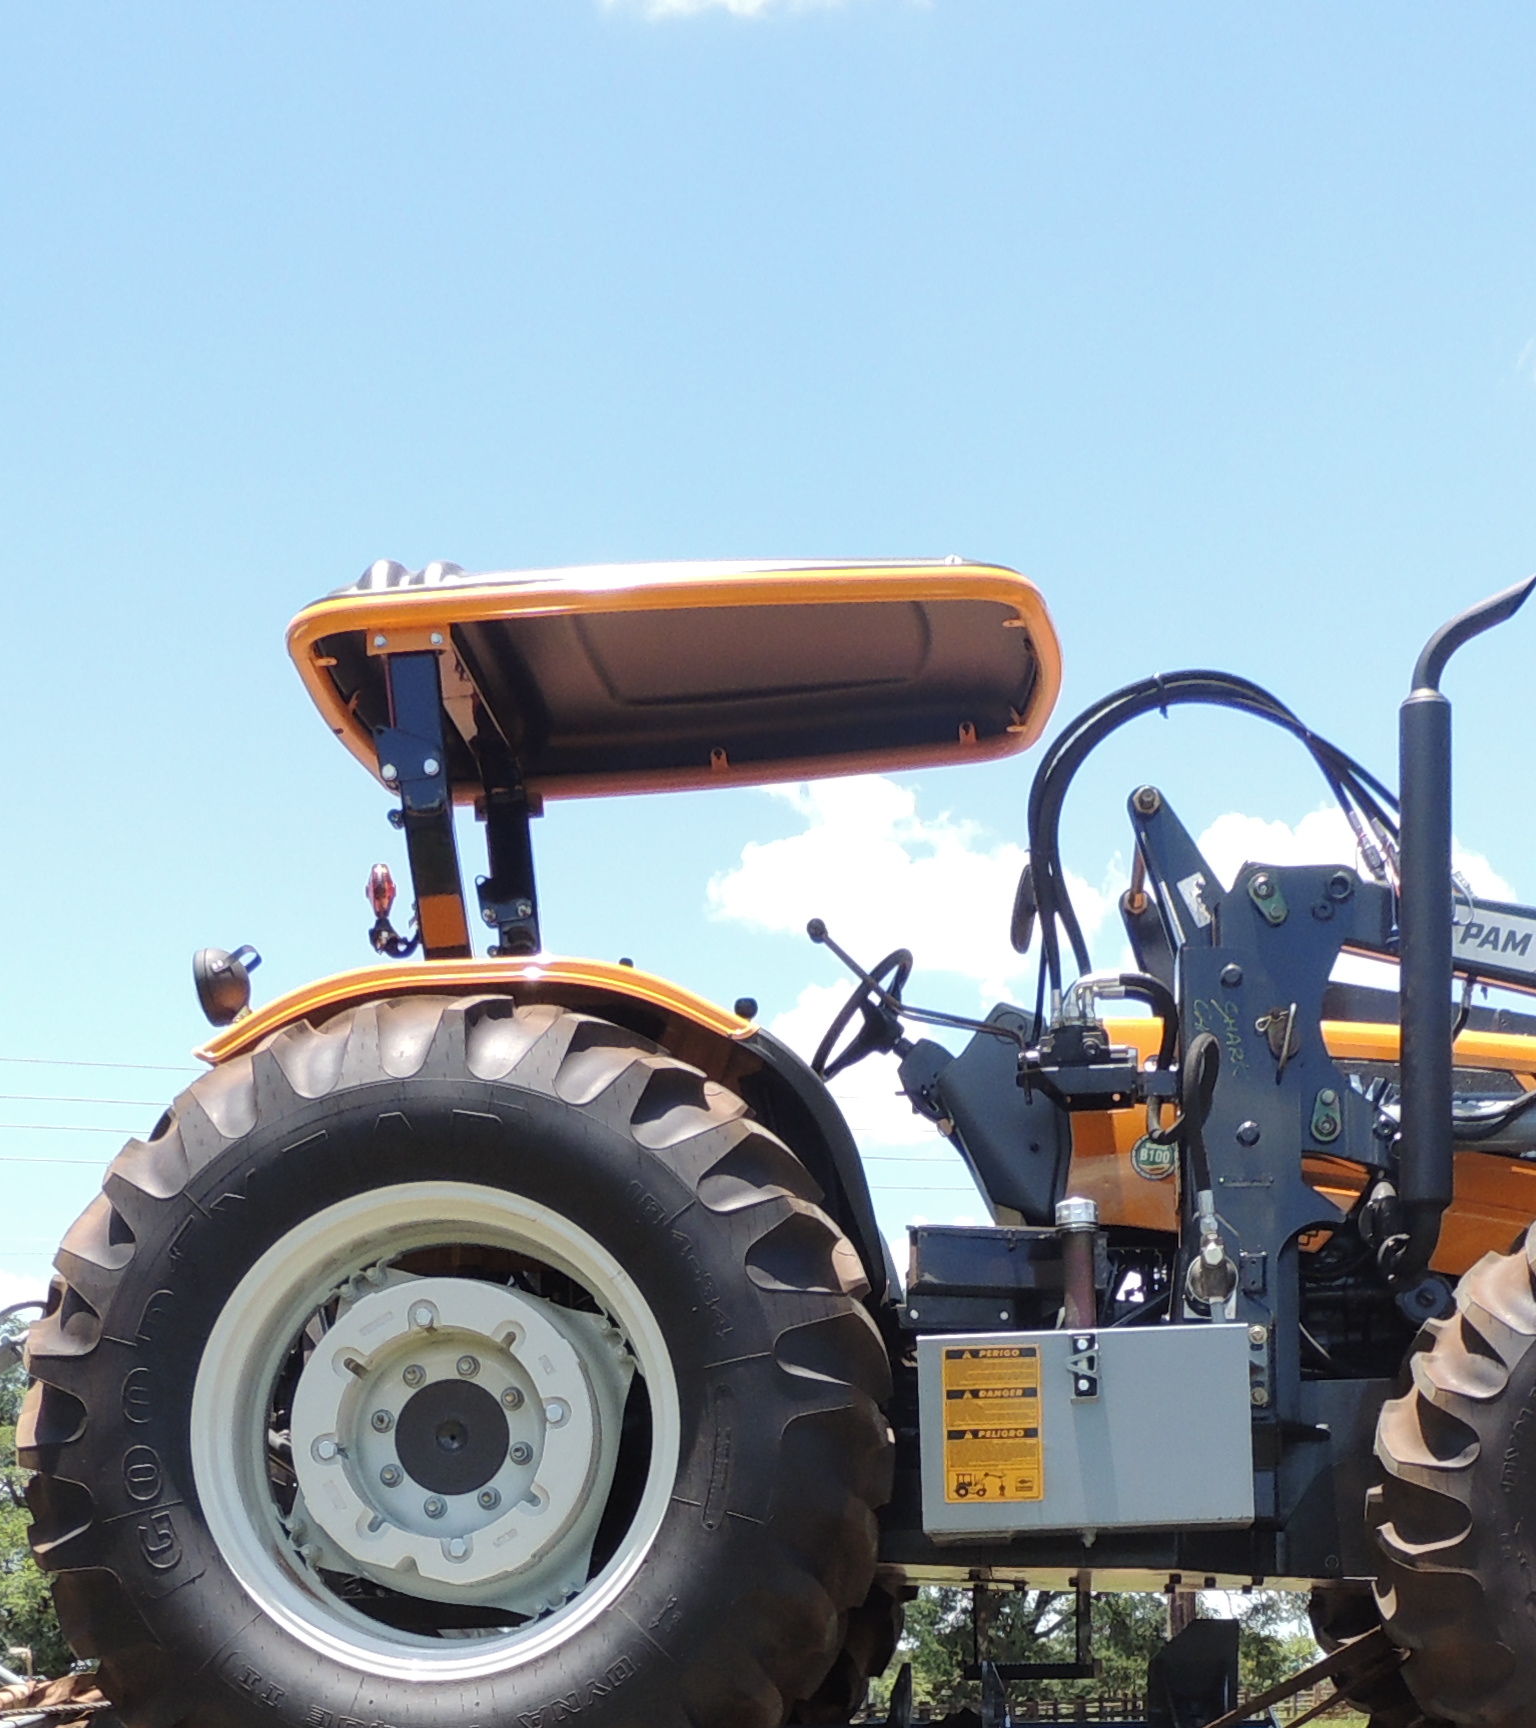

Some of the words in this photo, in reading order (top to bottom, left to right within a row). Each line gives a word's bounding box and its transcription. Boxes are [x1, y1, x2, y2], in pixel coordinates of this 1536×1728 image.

[1459, 921, 1534, 958] PAM
[1139, 1147, 1170, 1163] B100
[121, 1108, 506, 1572] GOODY
[978, 1348, 1021, 1358] PERIGO
[978, 1388, 1024, 1398] DANGER
[977, 1429, 1026, 1439] PELIGRO
